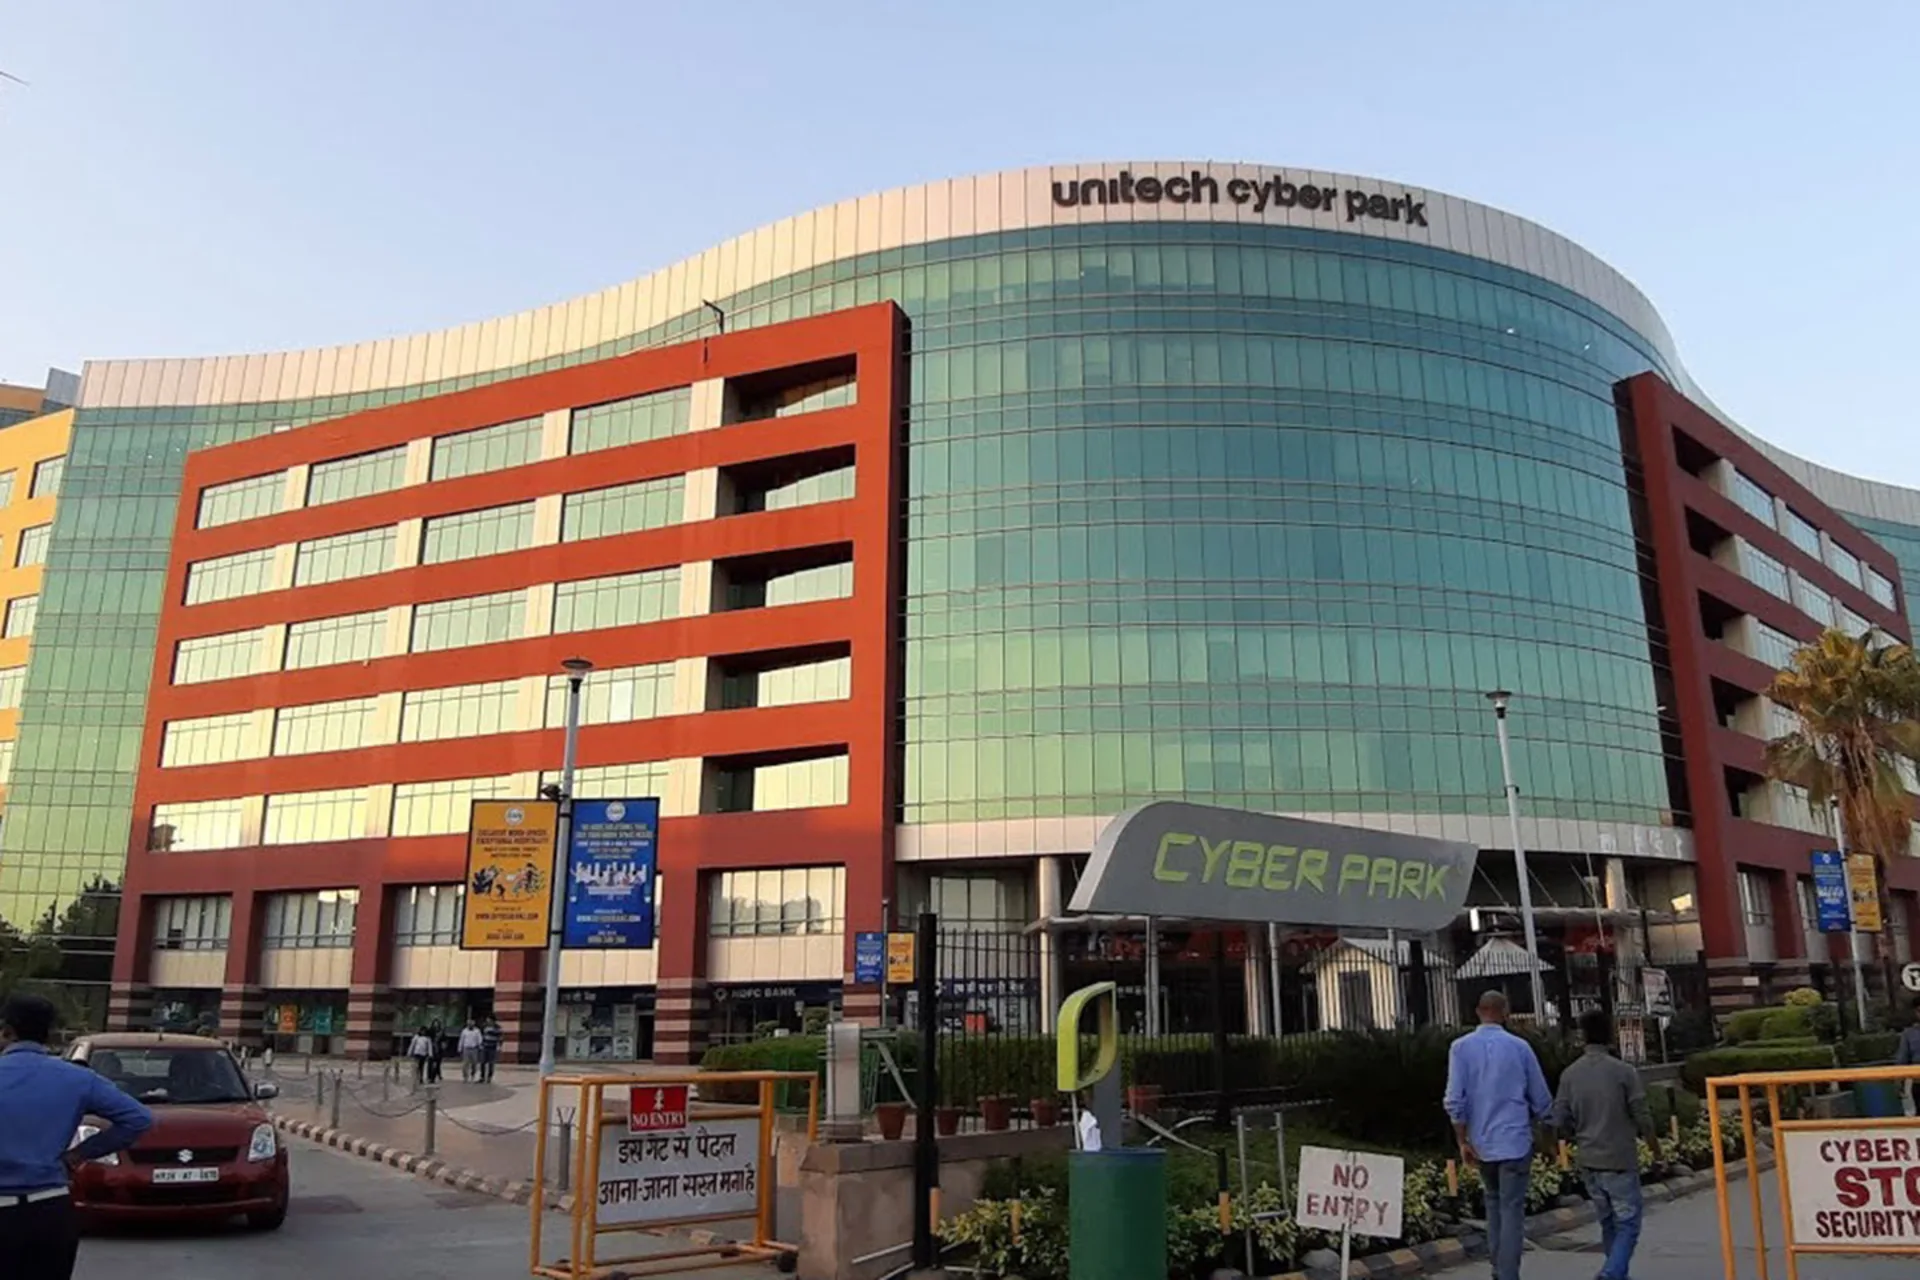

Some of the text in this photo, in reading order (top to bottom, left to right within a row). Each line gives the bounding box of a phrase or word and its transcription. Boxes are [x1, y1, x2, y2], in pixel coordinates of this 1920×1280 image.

[1052, 171, 1428, 227] unitech cyber park
[1153, 831, 1449, 901] CYBER PARK
[764, 987, 797, 998] BANK
[632, 1111, 684, 1127] NO ENTRY
[696, 1124, 737, 1160] पैदल
[1820, 1138, 1911, 1162] CYBER
[1332, 1163, 1369, 1190] NO
[1306, 1192, 1389, 1226] ENTRY
[1816, 1210, 1920, 1238] SECURITY
